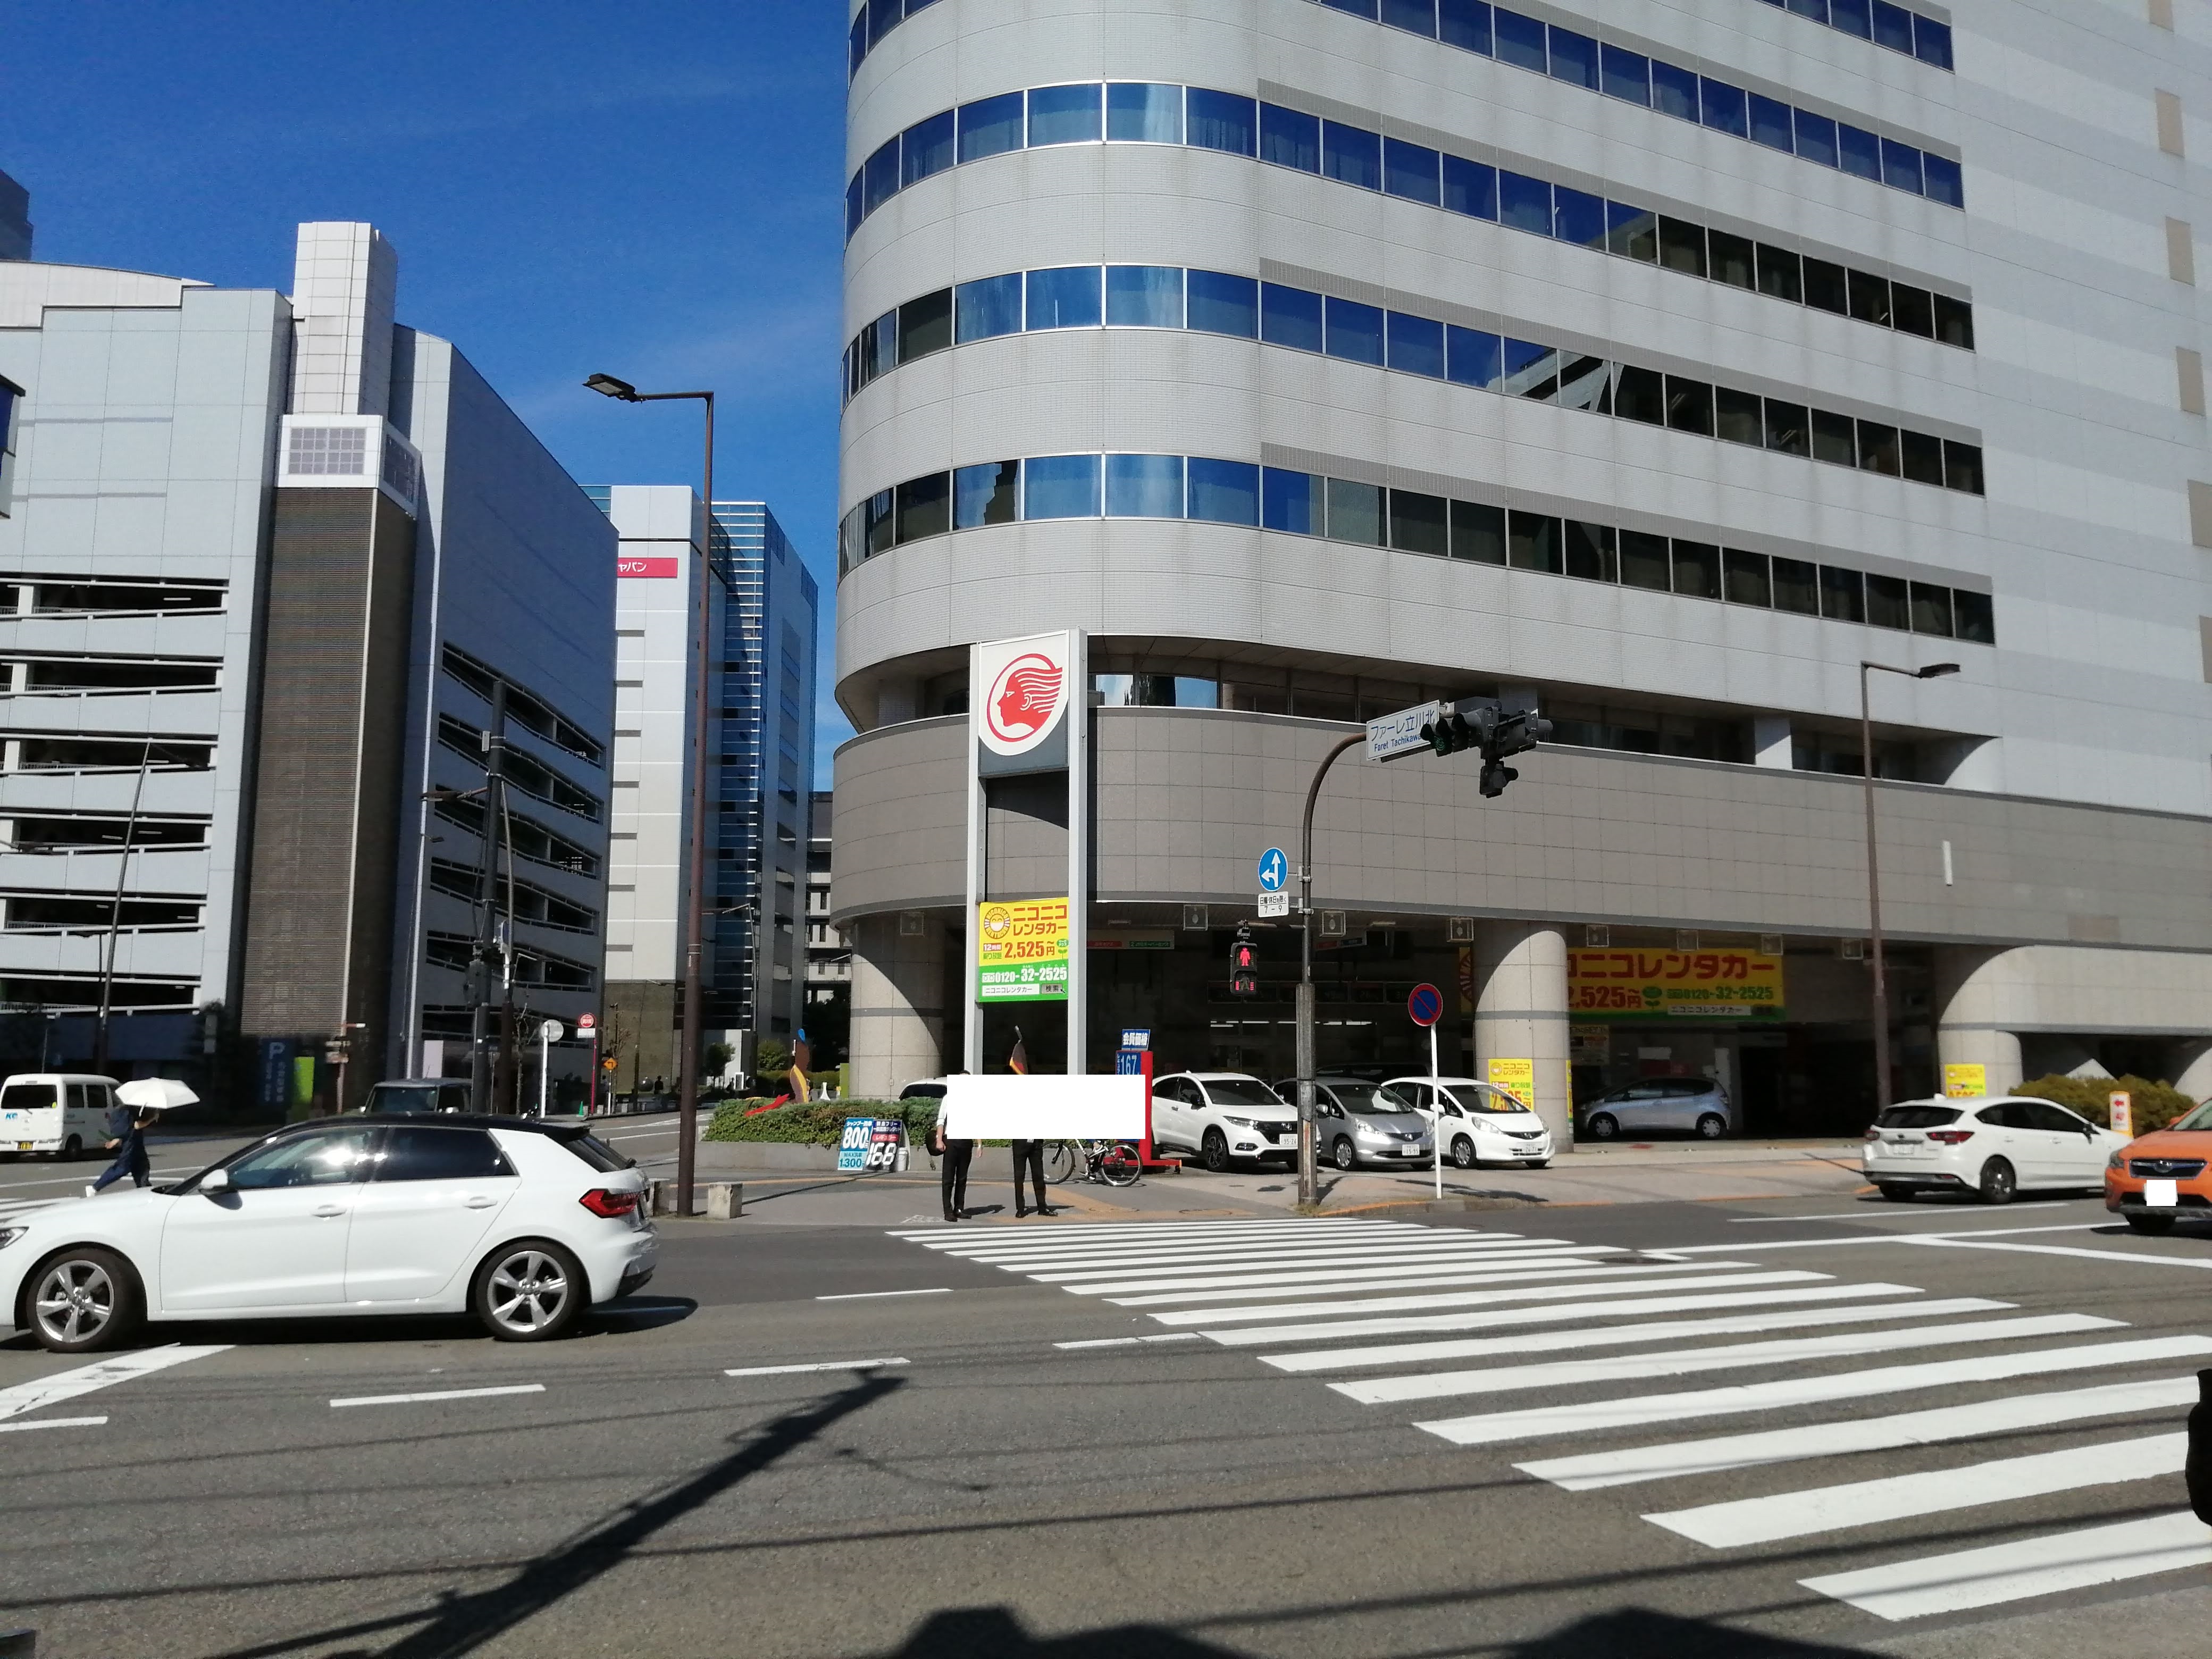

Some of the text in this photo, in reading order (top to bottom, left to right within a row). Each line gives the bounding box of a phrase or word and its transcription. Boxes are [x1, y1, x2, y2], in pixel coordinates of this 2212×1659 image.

[1371, 709, 1435, 741] ファーレ立川北
[1374, 740, 1389, 752] Faret
[1013, 905, 1067, 921] ニコニコ
[1013, 923, 1067, 936] レンタカー
[995, 967, 1067, 983] 0120-32-2525
[1123, 1032, 1148, 1046] 会員価格
[269, 1042, 286, 1060] P
[866, 1142, 897, 1166] 168
